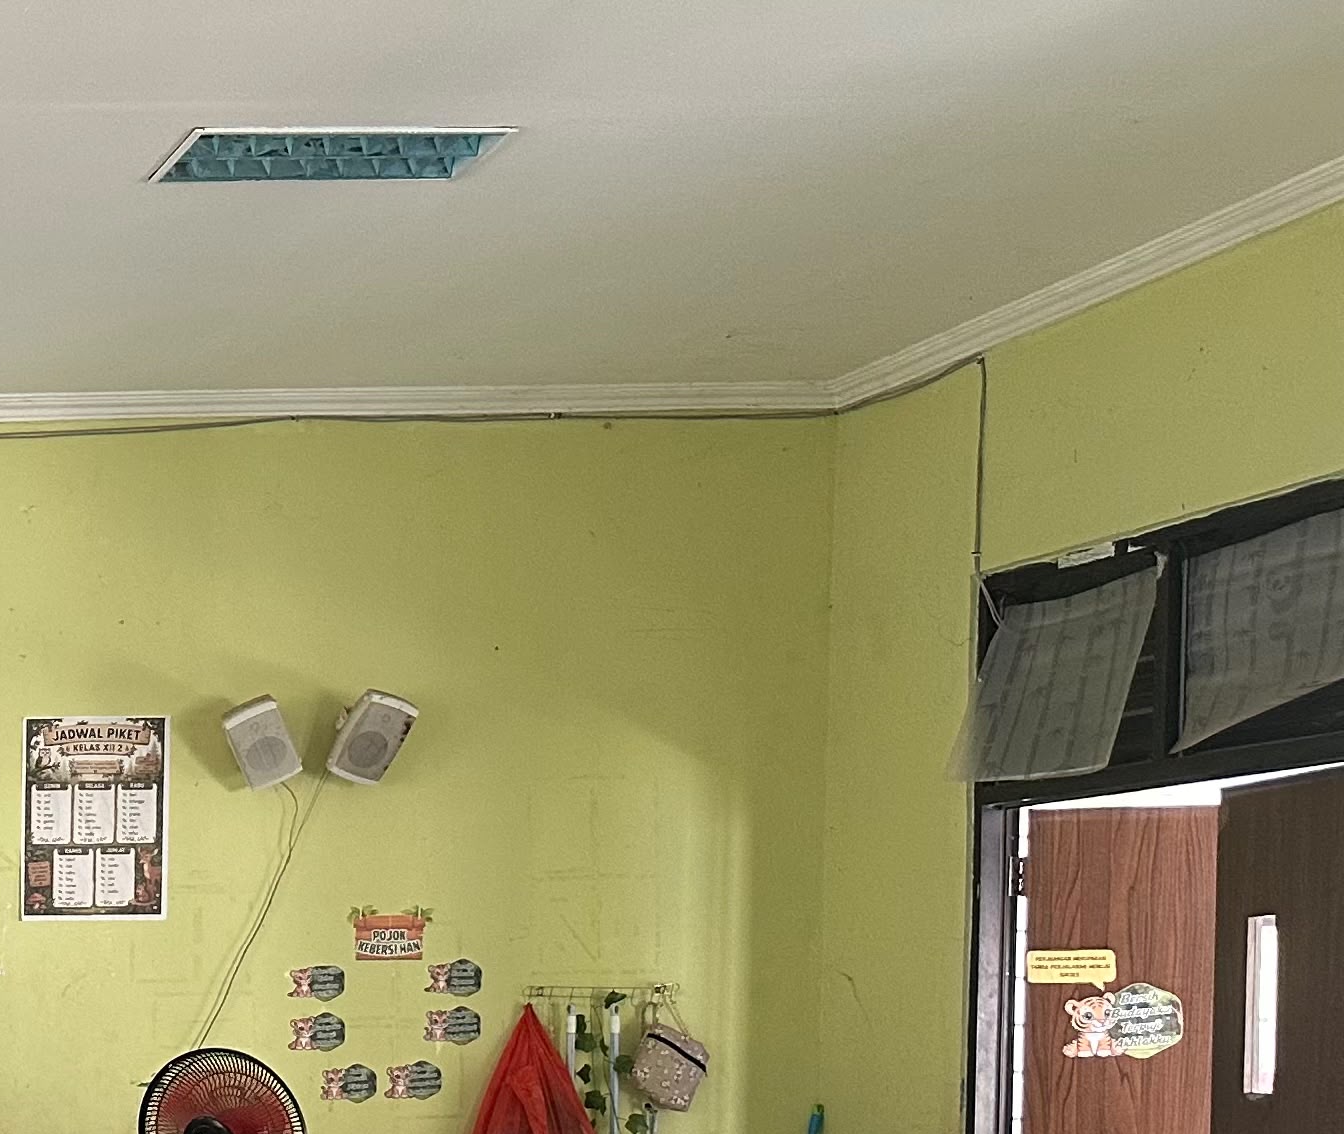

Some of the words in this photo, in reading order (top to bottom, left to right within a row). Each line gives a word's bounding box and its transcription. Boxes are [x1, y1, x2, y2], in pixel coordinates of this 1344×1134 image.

[52, 728, 103, 741] JADWAL
[107, 728, 141, 740] PIKET
[73, 744, 100, 752] KELAS
[117, 744, 123, 752] 2
[372, 930, 406, 941] POJOK
